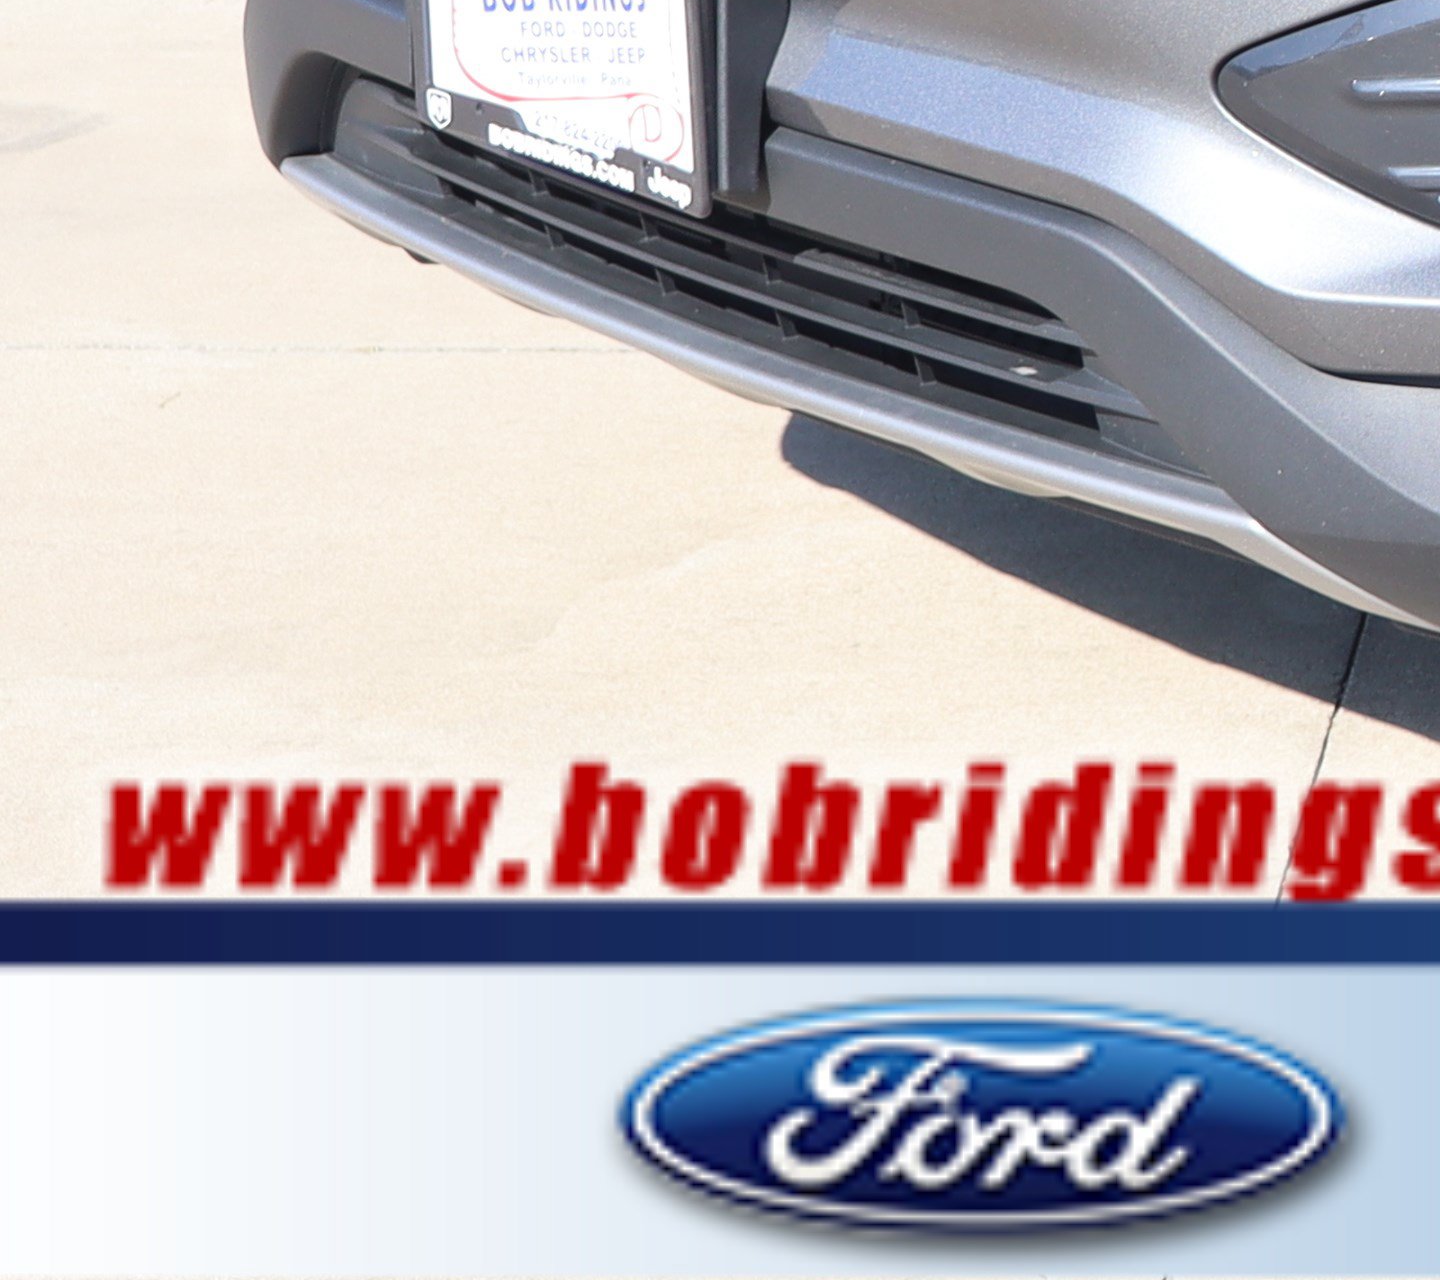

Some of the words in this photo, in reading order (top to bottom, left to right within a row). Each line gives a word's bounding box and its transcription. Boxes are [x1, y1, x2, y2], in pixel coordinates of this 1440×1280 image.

[520, 20, 566, 38] FORD
[582, 20, 638, 39] DODGE
[501, 46, 592, 64] CHRYSLER
[608, 46, 647, 64] JEEP
